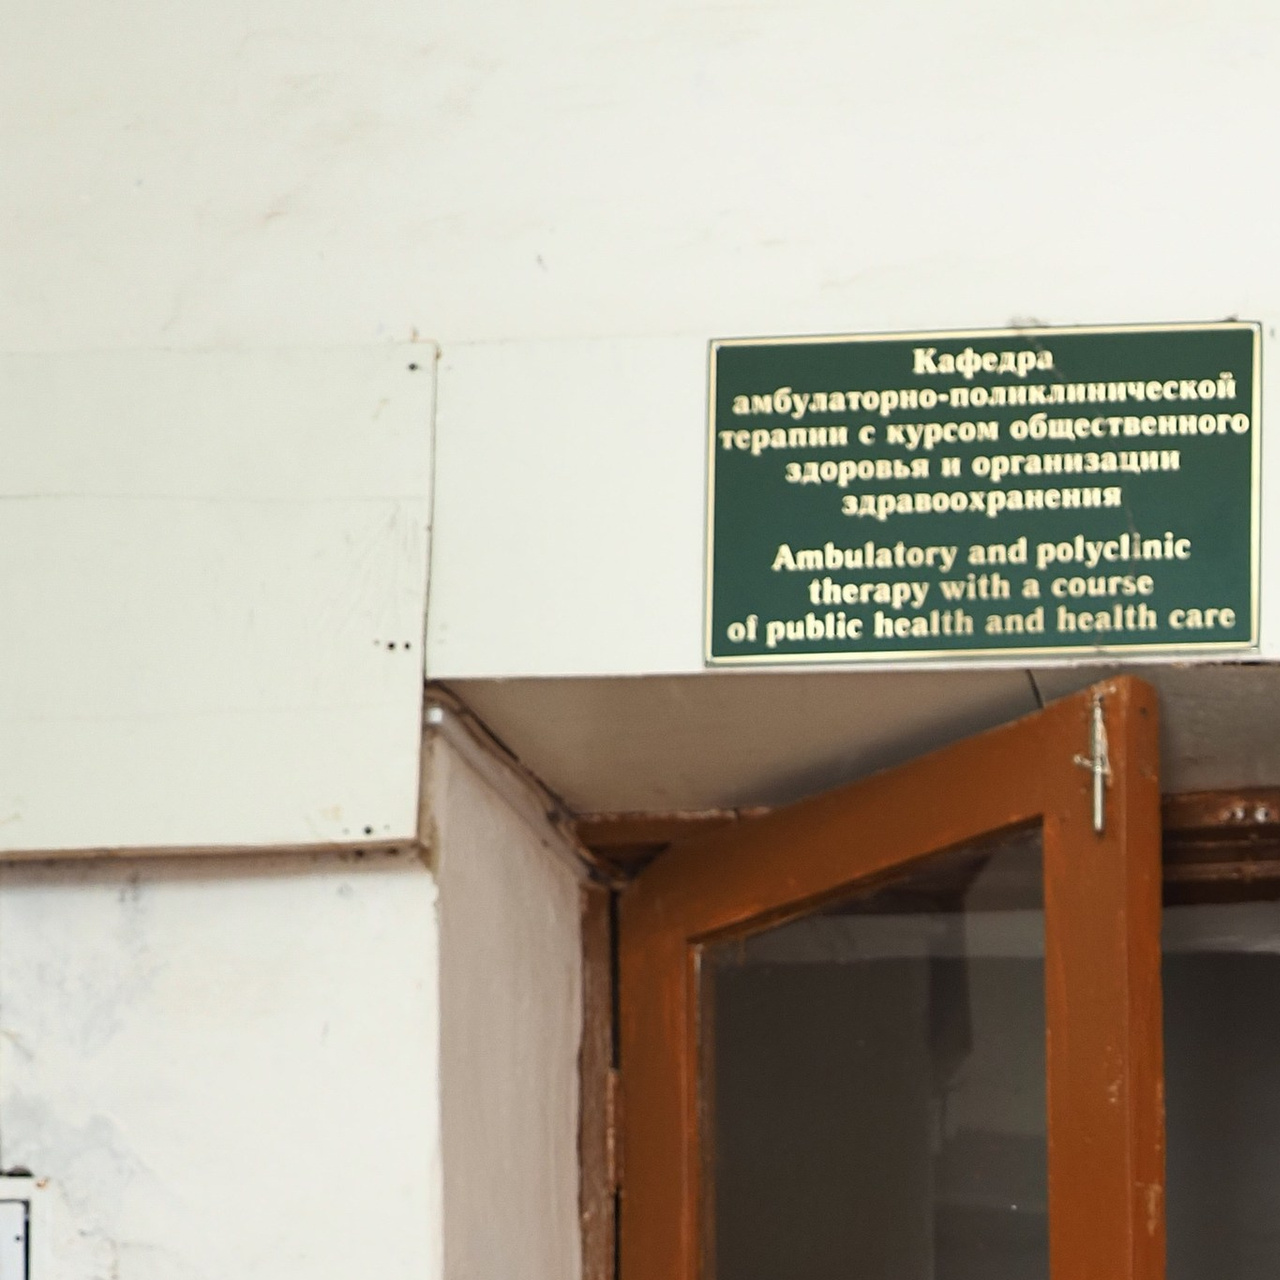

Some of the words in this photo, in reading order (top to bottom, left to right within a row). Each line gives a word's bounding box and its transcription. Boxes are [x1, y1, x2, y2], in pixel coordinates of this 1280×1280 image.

[913, 347, 1054, 380] Кафедра
[732, 374, 1237, 419] амбулаторно-поликлинической
[718, 426, 848, 456] терапии
[858, 425, 876, 446] с
[886, 421, 999, 451] курсом
[1010, 413, 1250, 443] общественного
[785, 458, 930, 488] здоровья
[941, 457, 961, 478] и
[971, 450, 1181, 477] организации
[841, 486, 1122, 520] здравоохранения
[771, 541, 958, 573] Ambulatory
[967, 536, 1028, 565] and
[1036, 531, 1191, 571] polyclinic
[808, 576, 930, 610] therapy
[939, 572, 1011, 601] with
[1021, 578, 1041, 599] a
[1051, 574, 1154, 598] course
[727, 614, 759, 642] of
[766, 611, 863, 648] public
[873, 605, 974, 639] health
[985, 606, 1045, 635] and
[1057, 602, 1157, 633] health
[1168, 607, 1236, 630] care
